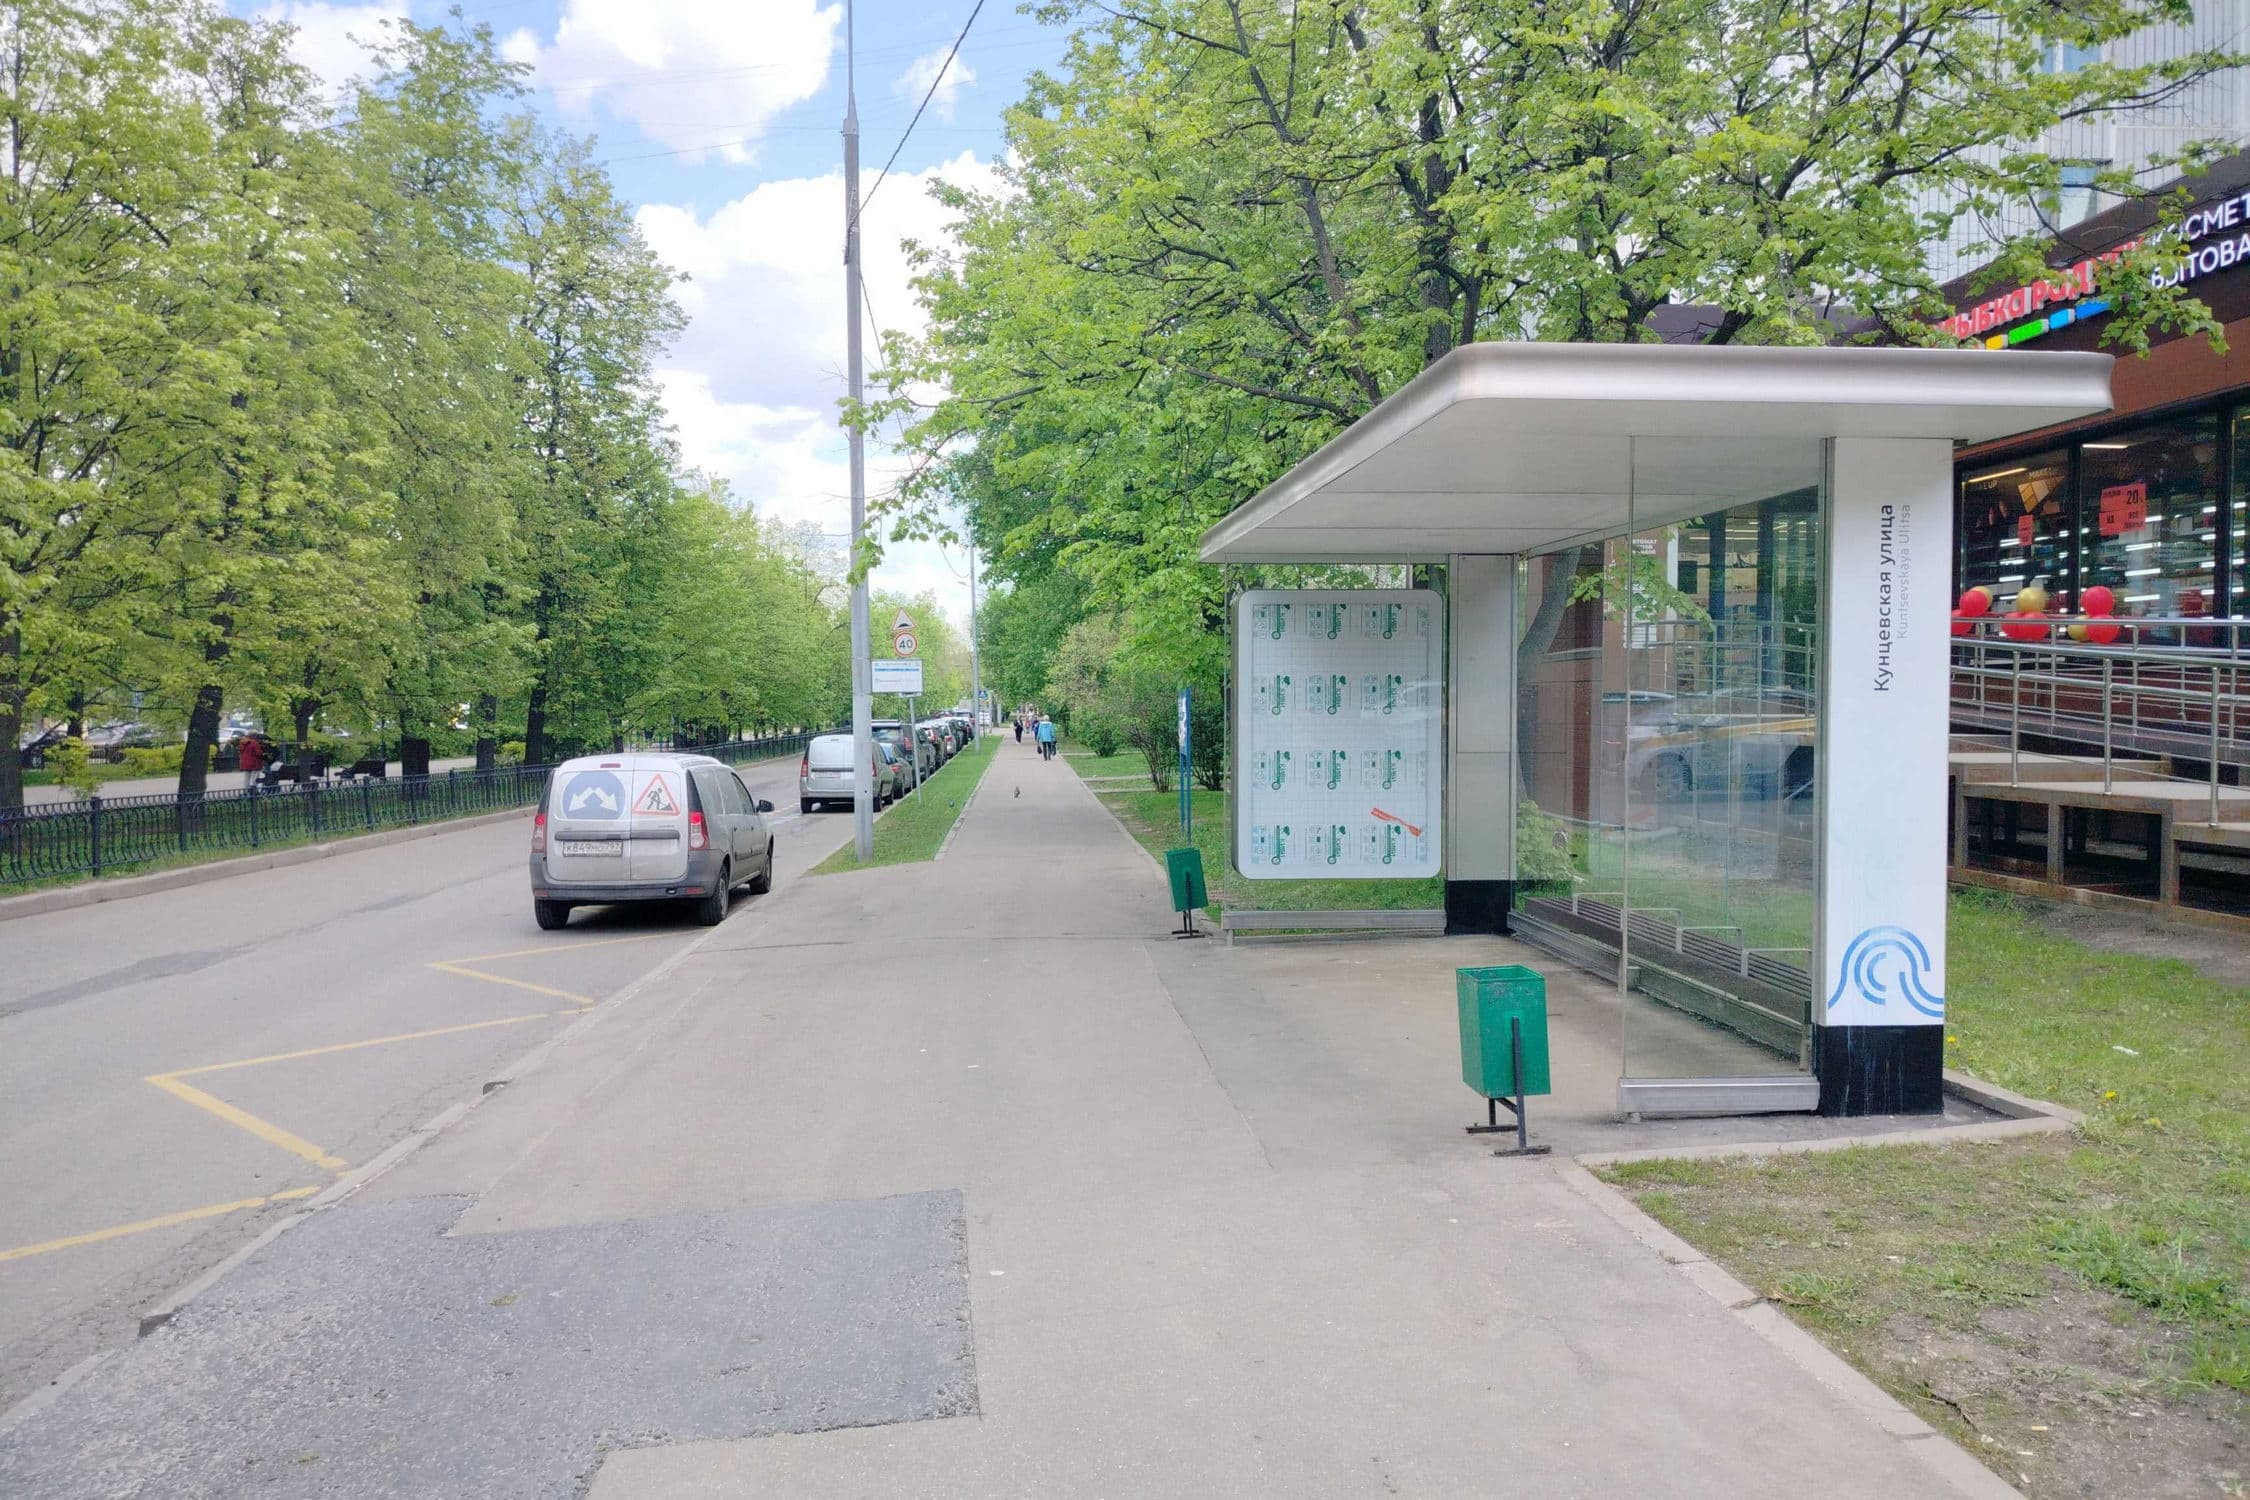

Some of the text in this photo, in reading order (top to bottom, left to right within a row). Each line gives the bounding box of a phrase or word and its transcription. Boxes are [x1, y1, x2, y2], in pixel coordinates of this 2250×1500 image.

[1873, 504, 1896, 692] Кунцевская улица
[1896, 504, 1912, 639] Kuntsevskaya Ulitsa
[899, 639, 914, 649] 40
